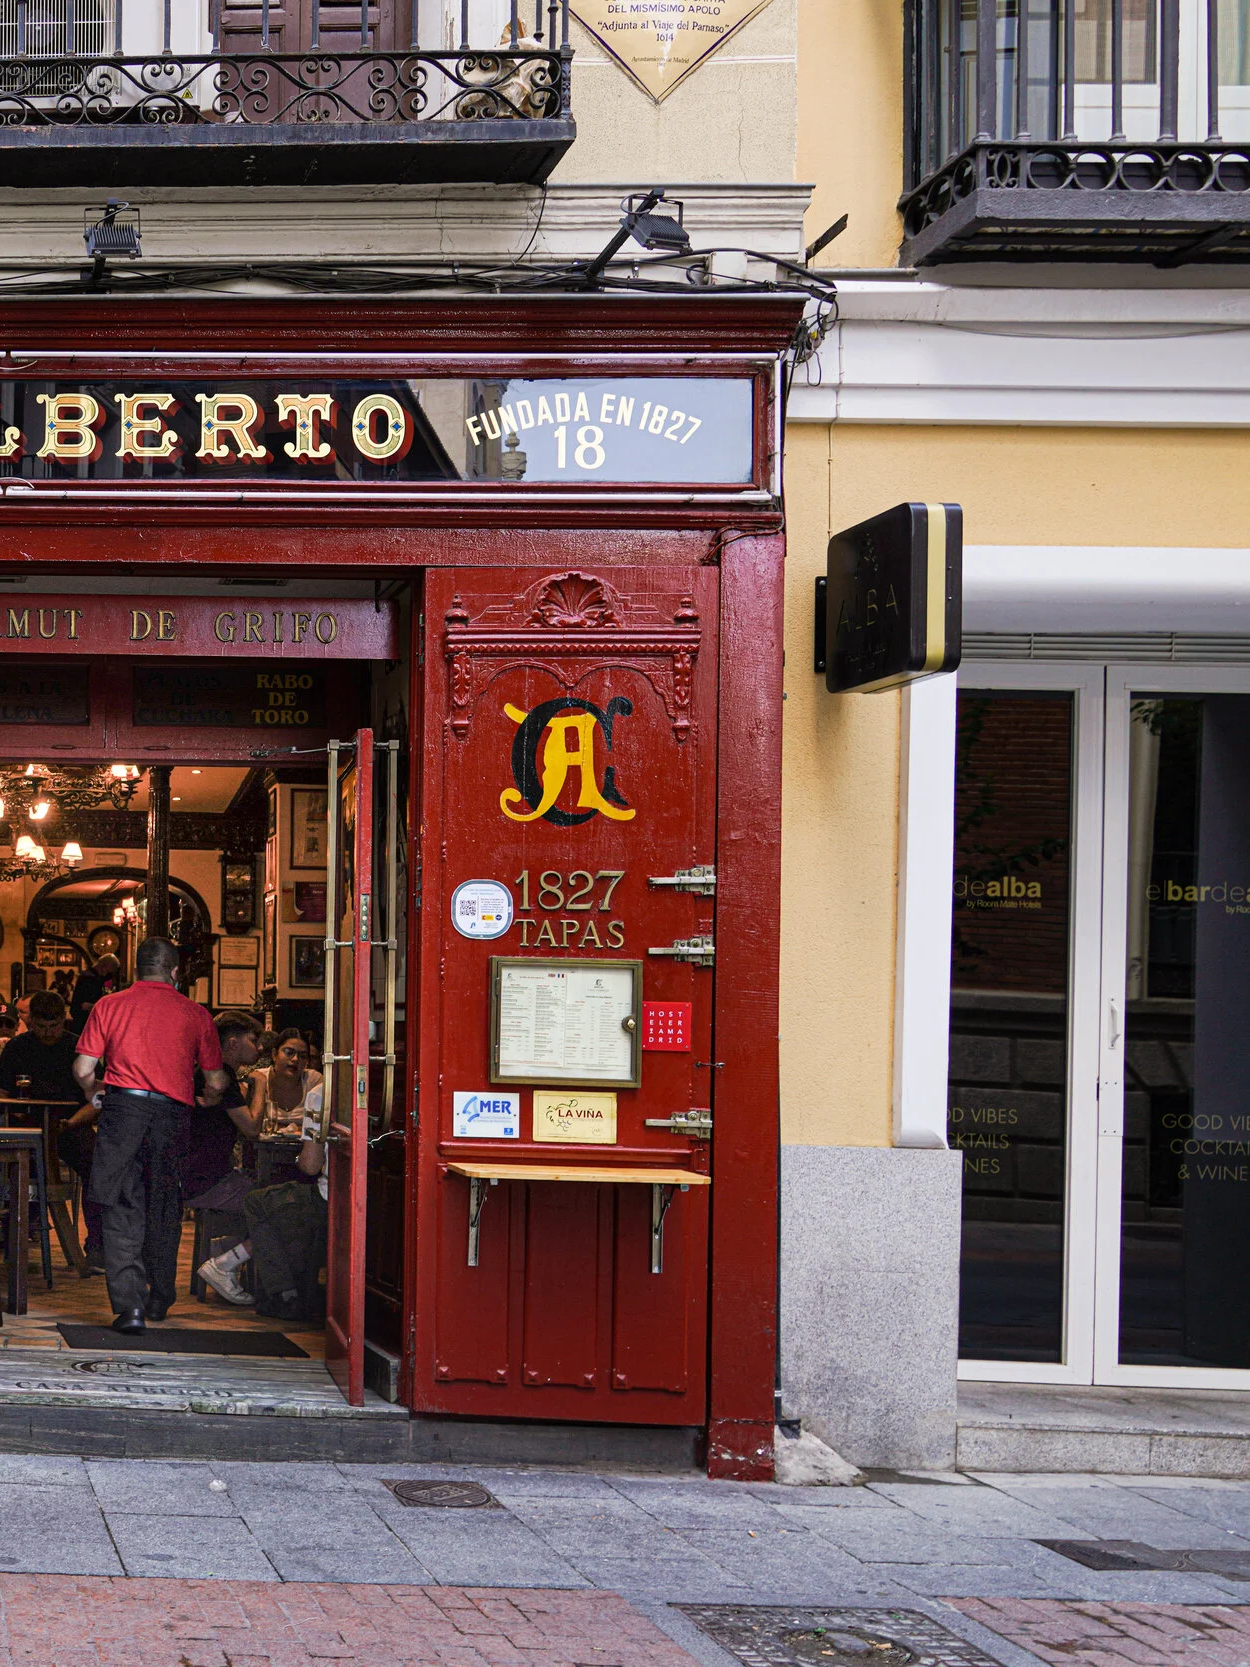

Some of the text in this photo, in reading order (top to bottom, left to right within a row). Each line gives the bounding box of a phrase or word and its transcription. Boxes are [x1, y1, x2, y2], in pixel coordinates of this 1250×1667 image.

[608, 3, 721, 15] DEL MISMÍSIMO APOLO
[640, 20, 649, 29] al
[652, 20, 674, 31] Viaje
[676, 20, 689, 30] del
[656, 33, 674, 42] 1614
[465, 391, 703, 446] FUNDADA EN 1827
[554, 425, 606, 470] 18
[129, 610, 178, 641] DE
[214, 610, 339, 644] GRIFO
[256, 674, 314, 689] RABO
[268, 691, 297, 706] DE
[251, 708, 310, 725] TORO
[515, 869, 626, 912] 1827
[966, 900, 976, 909] by
[977, 900, 999, 908] Room
[1225, 905, 1235, 914] by
[513, 919, 625, 949] TAPAS
[648, 1036, 683, 1044] DRID
[558, 1108, 603, 1118] LA VIÑA
[971, 1108, 1018, 1125] VIBES
[1162, 1113, 1223, 1130] GOOD
[1178, 1164, 1190, 1180] &
[15, 1381, 85, 1391] CASA
